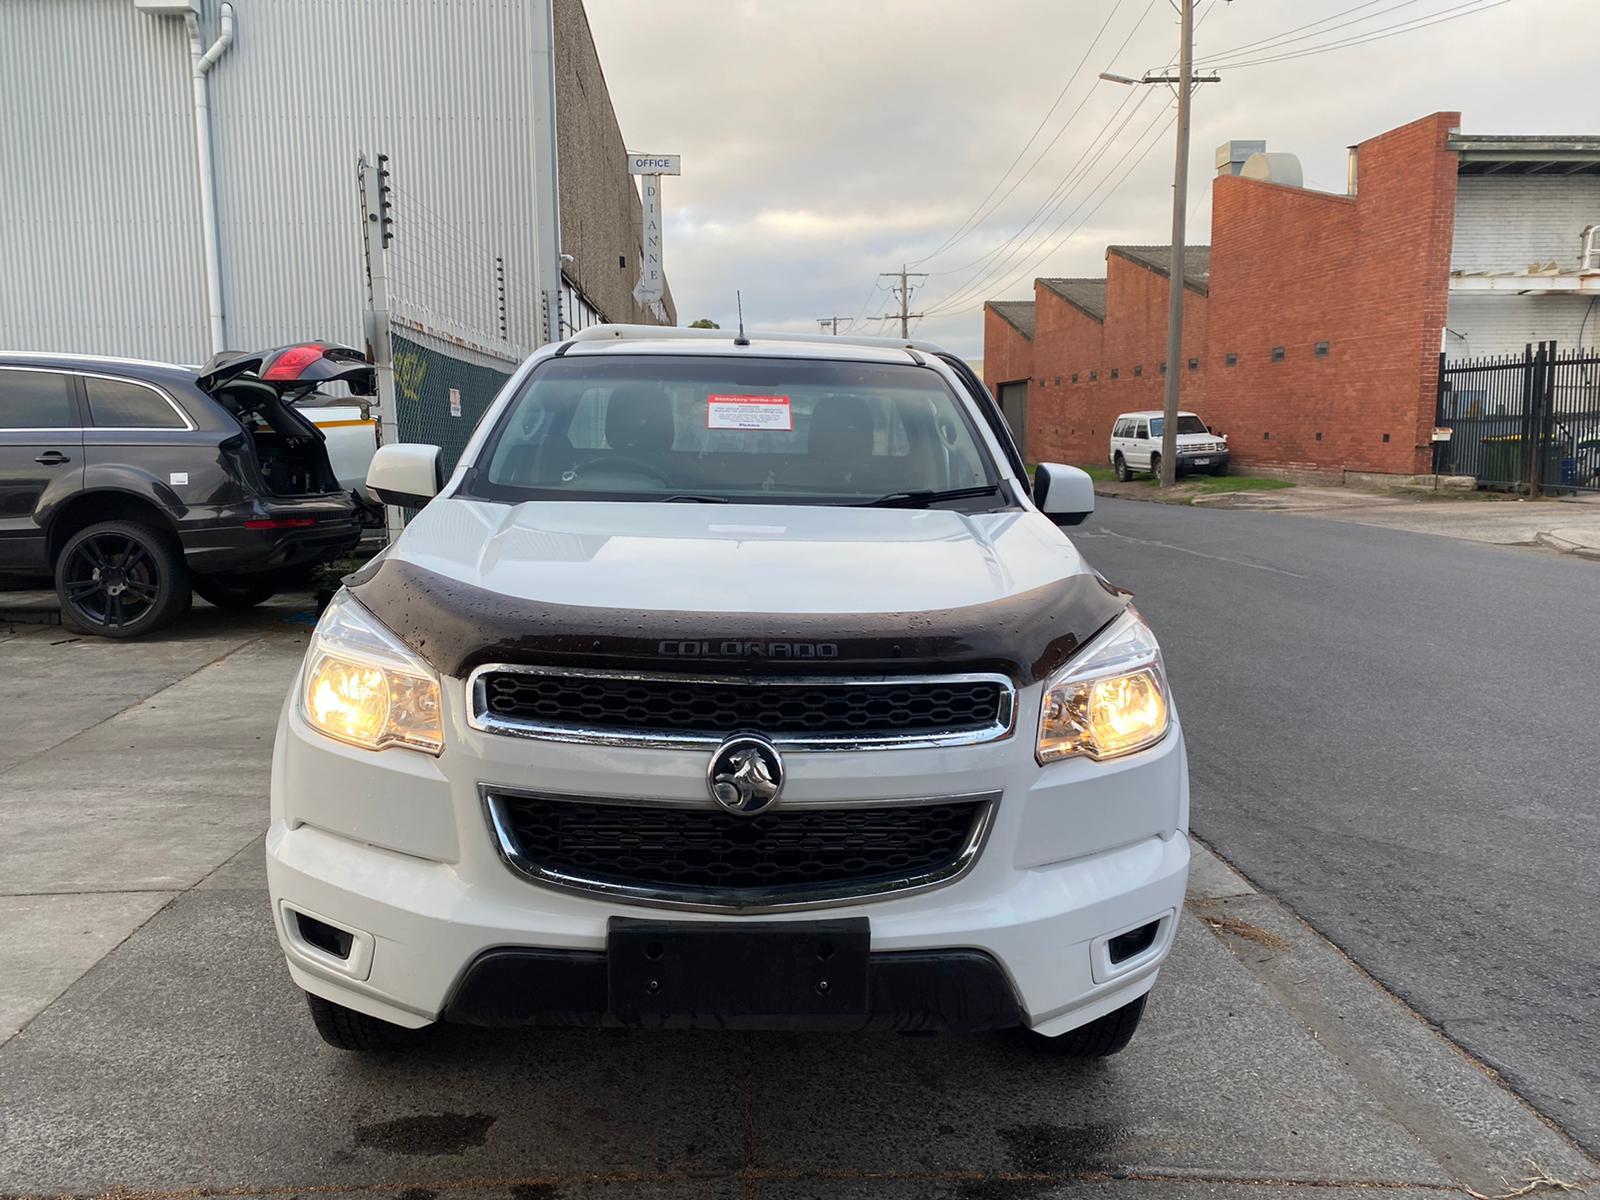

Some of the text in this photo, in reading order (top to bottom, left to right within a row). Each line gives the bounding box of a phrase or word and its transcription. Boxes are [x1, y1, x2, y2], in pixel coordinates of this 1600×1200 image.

[636, 159, 670, 168] OFFICE
[647, 186, 658, 280] DIANNE
[658, 640, 839, 657] COLORADO
